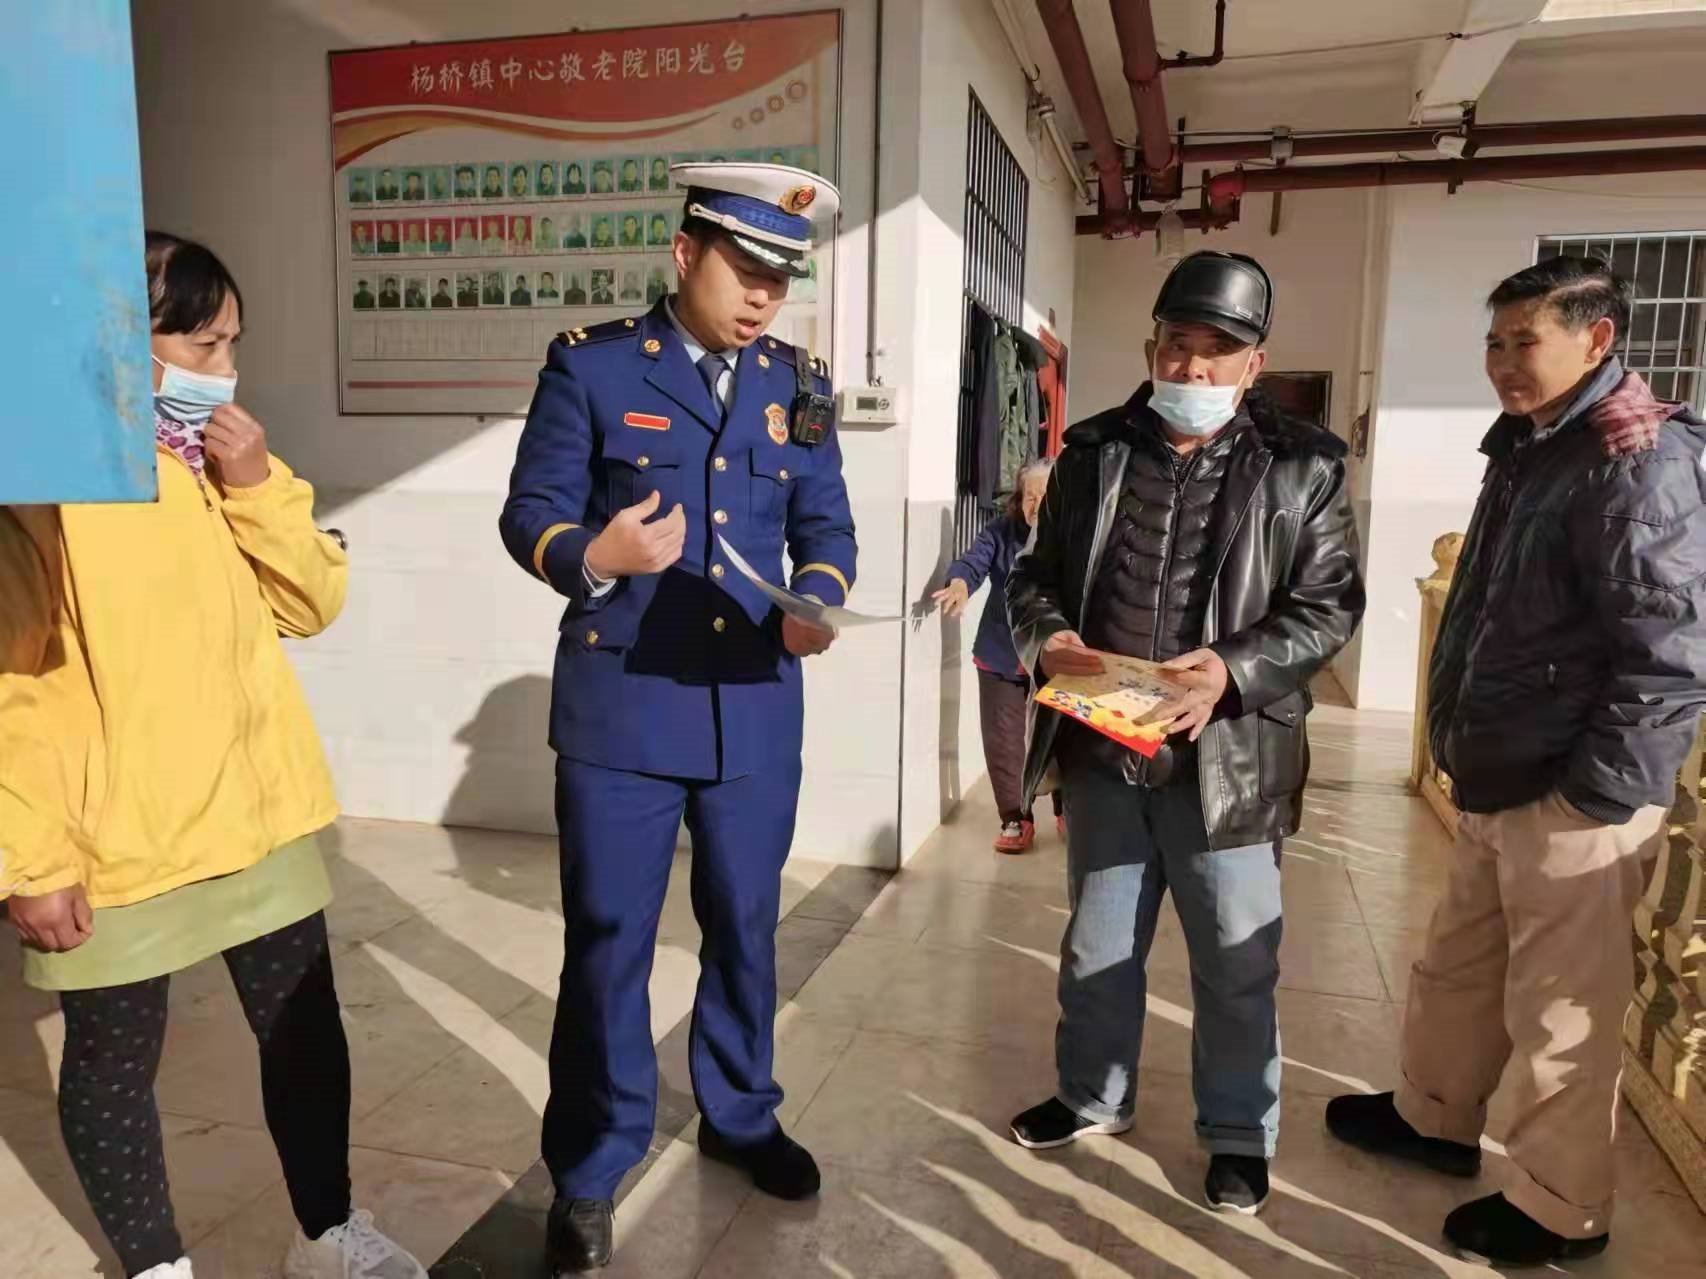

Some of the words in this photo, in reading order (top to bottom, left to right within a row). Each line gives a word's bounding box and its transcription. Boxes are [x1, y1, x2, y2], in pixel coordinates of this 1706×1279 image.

[410, 40, 746, 93] 杨桥镇中心敬老院阳光台
